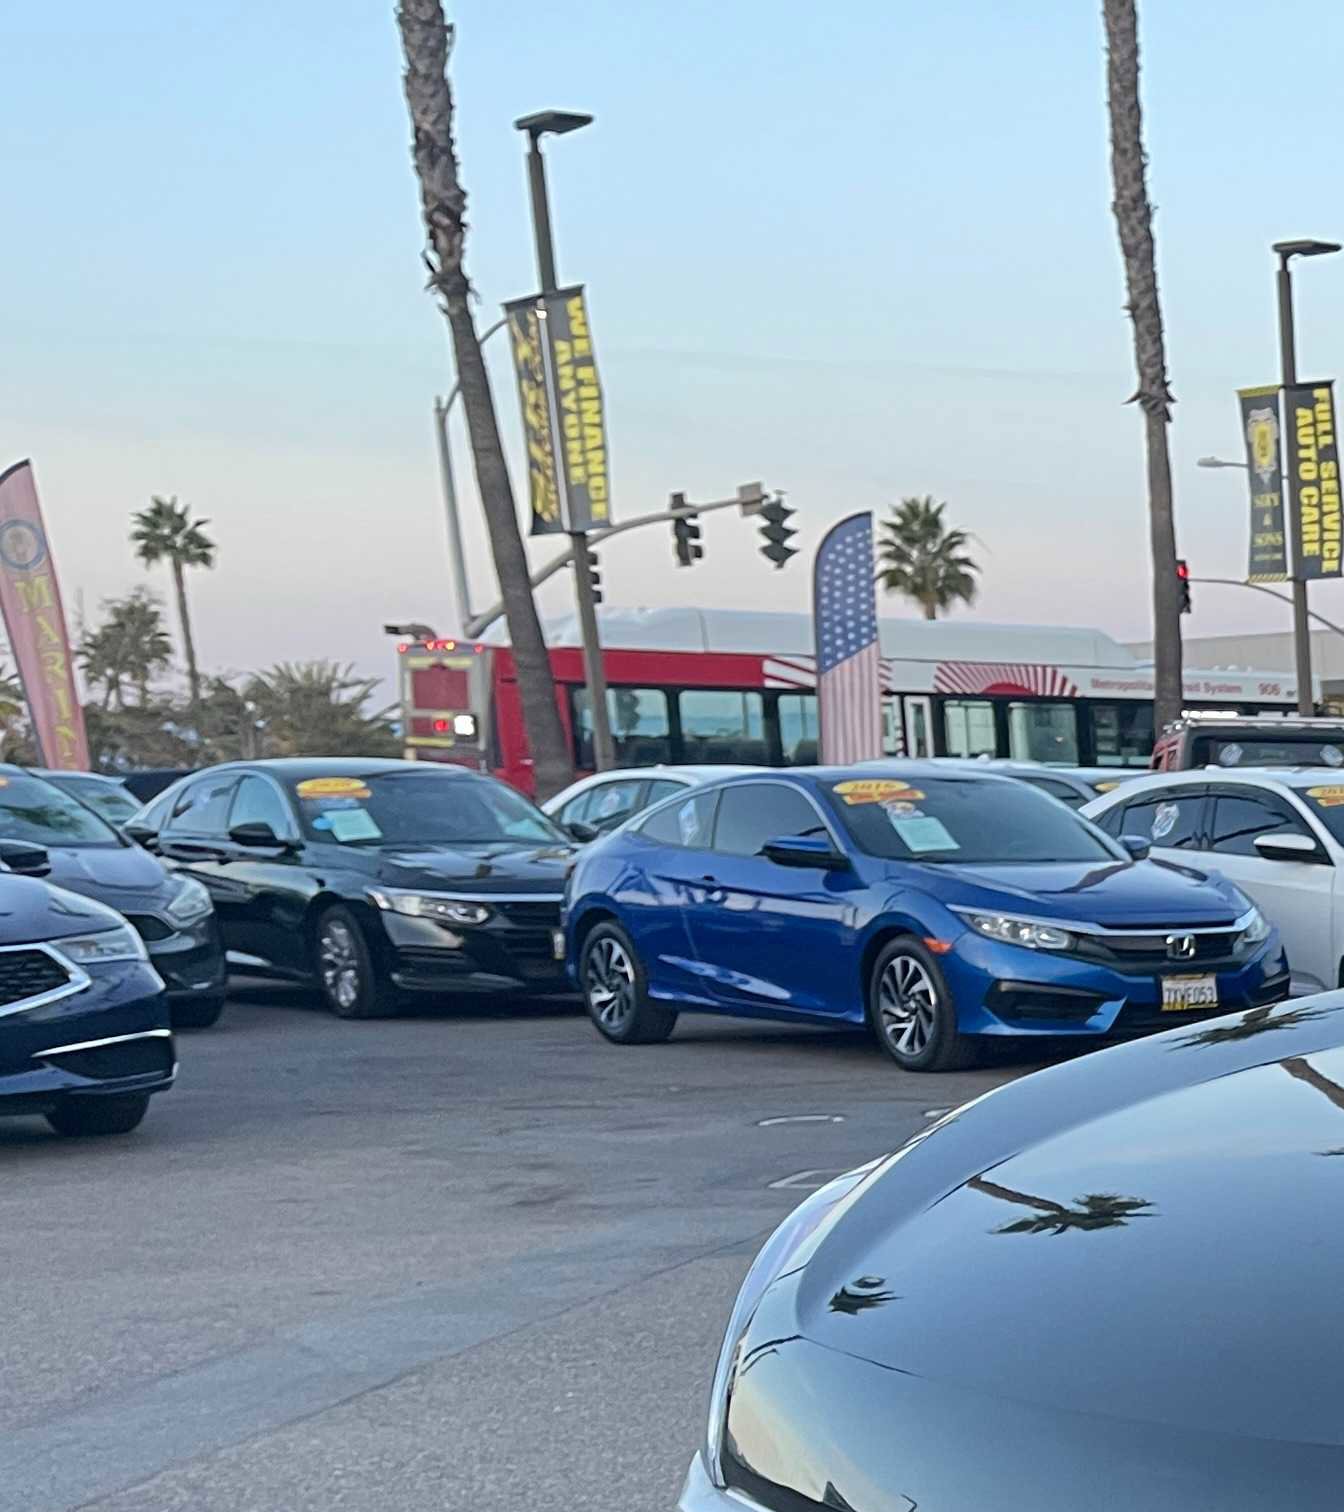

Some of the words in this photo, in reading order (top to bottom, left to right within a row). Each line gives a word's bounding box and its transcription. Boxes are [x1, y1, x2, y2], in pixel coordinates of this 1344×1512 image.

[566, 296, 592, 357] WE
[553, 339, 587, 486] ANYONE
[576, 364, 609, 522] FINANCE
[1295, 408, 1319, 480] AUTO
[1313, 388, 1335, 450] FULL
[1300, 486, 1320, 557] CARE
[1319, 461, 1342, 574] SERVICE
[1203, 681, 1244, 695] System
